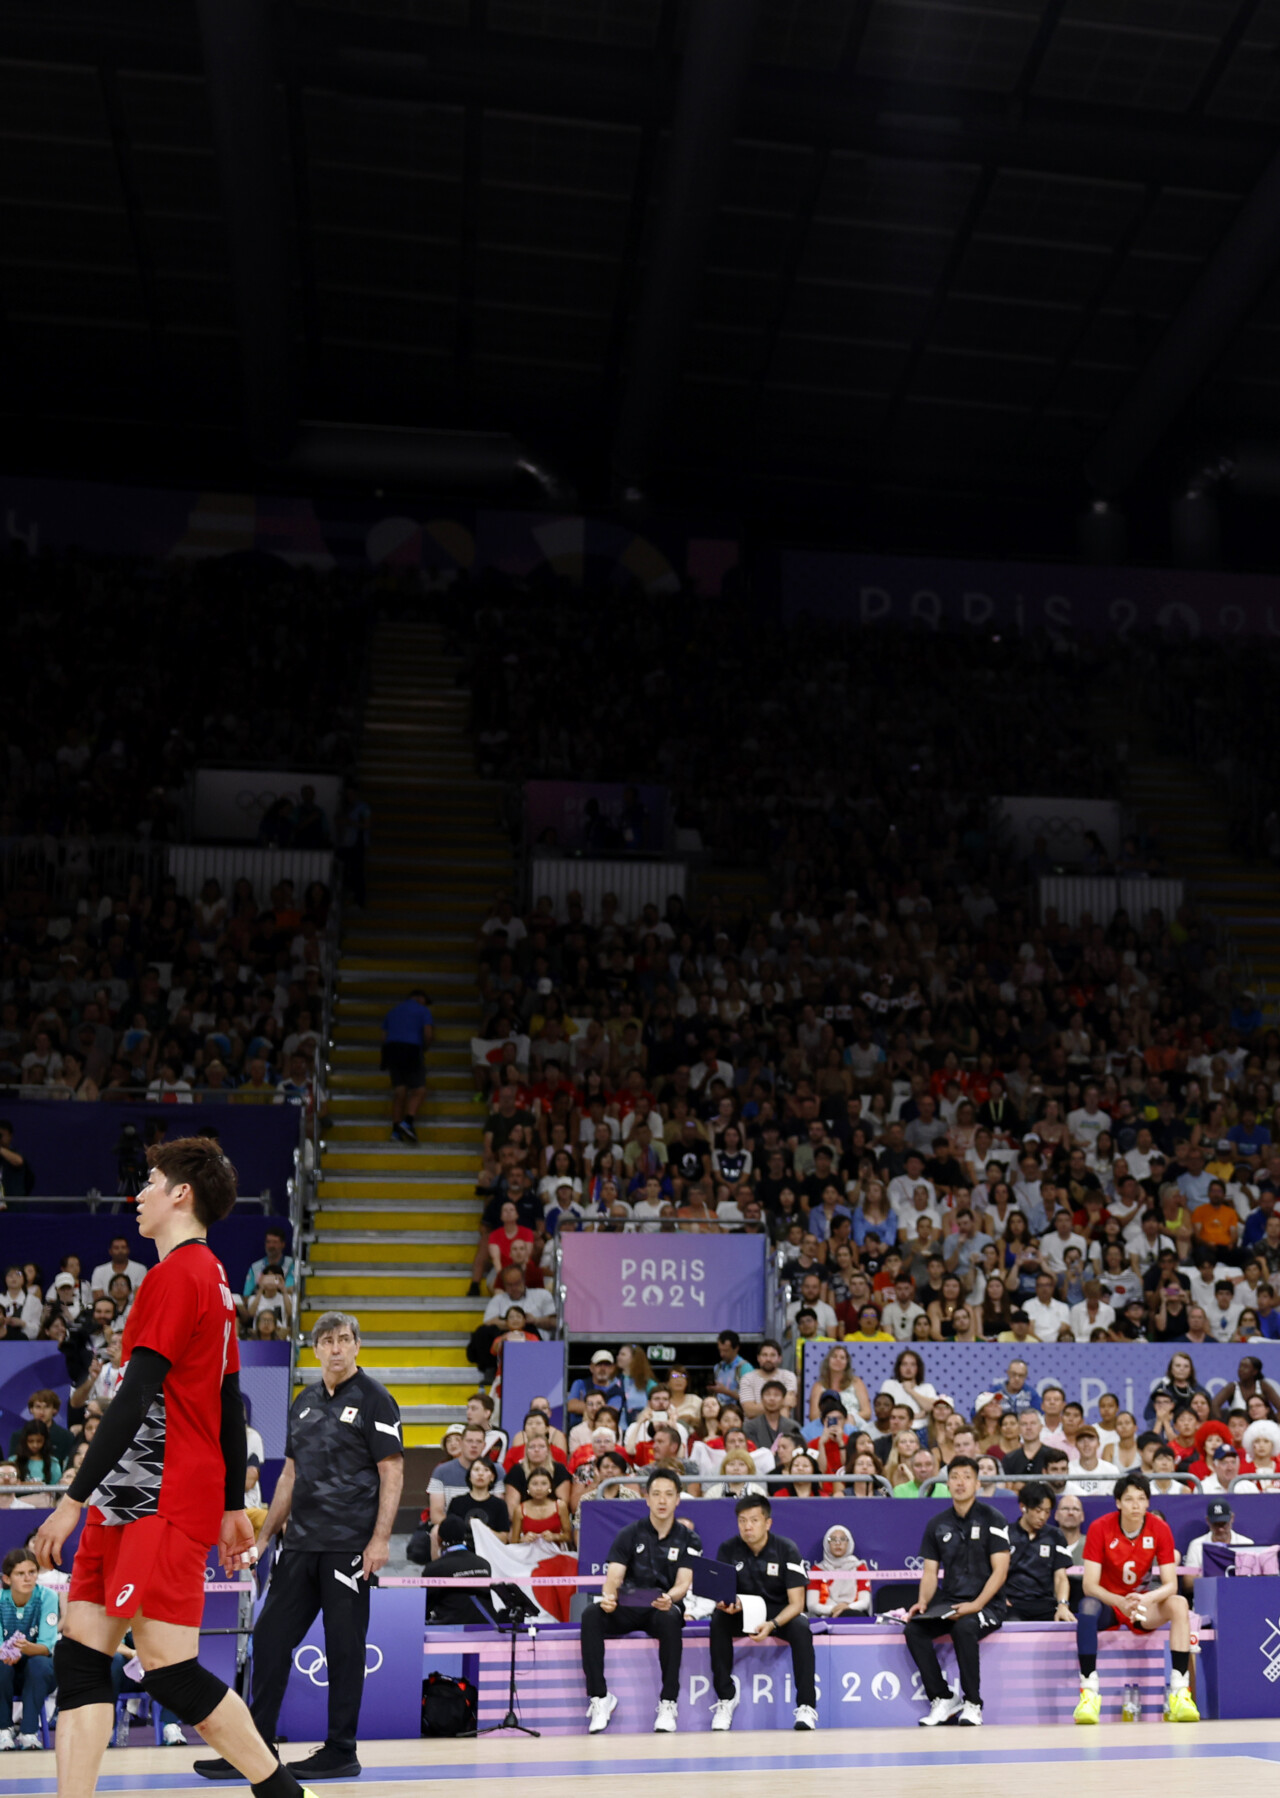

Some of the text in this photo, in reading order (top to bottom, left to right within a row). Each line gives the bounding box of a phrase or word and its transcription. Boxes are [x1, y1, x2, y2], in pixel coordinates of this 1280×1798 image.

[621, 1259, 705, 1281] PARIS
[621, 1285, 705, 1307] 2024
[1122, 1560, 1137, 1585] 6
